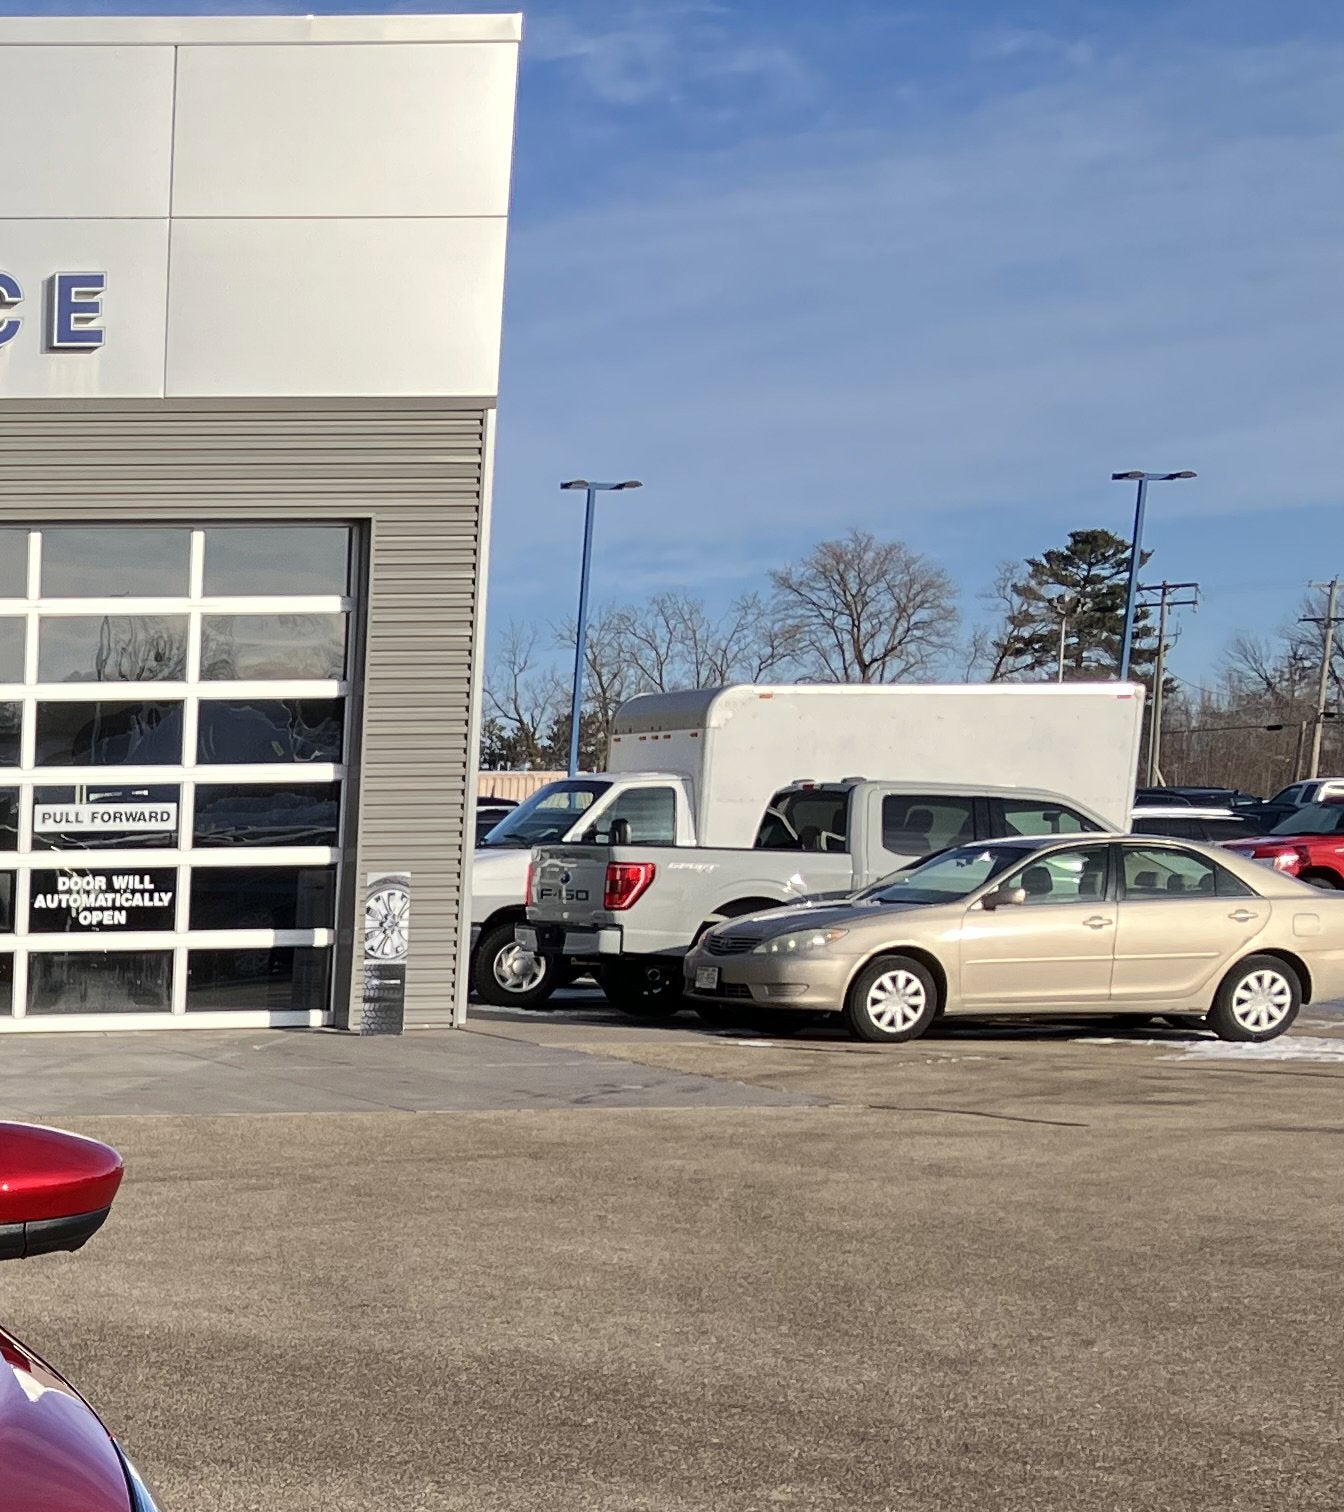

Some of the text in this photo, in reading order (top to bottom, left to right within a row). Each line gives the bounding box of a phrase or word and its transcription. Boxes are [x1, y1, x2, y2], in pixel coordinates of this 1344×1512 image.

[41, 810, 171, 825] PULL FORWARD
[57, 874, 155, 891] DOOR WILL
[33, 892, 173, 909] AUTOMATICALLY
[78, 909, 127, 926] OPEN
